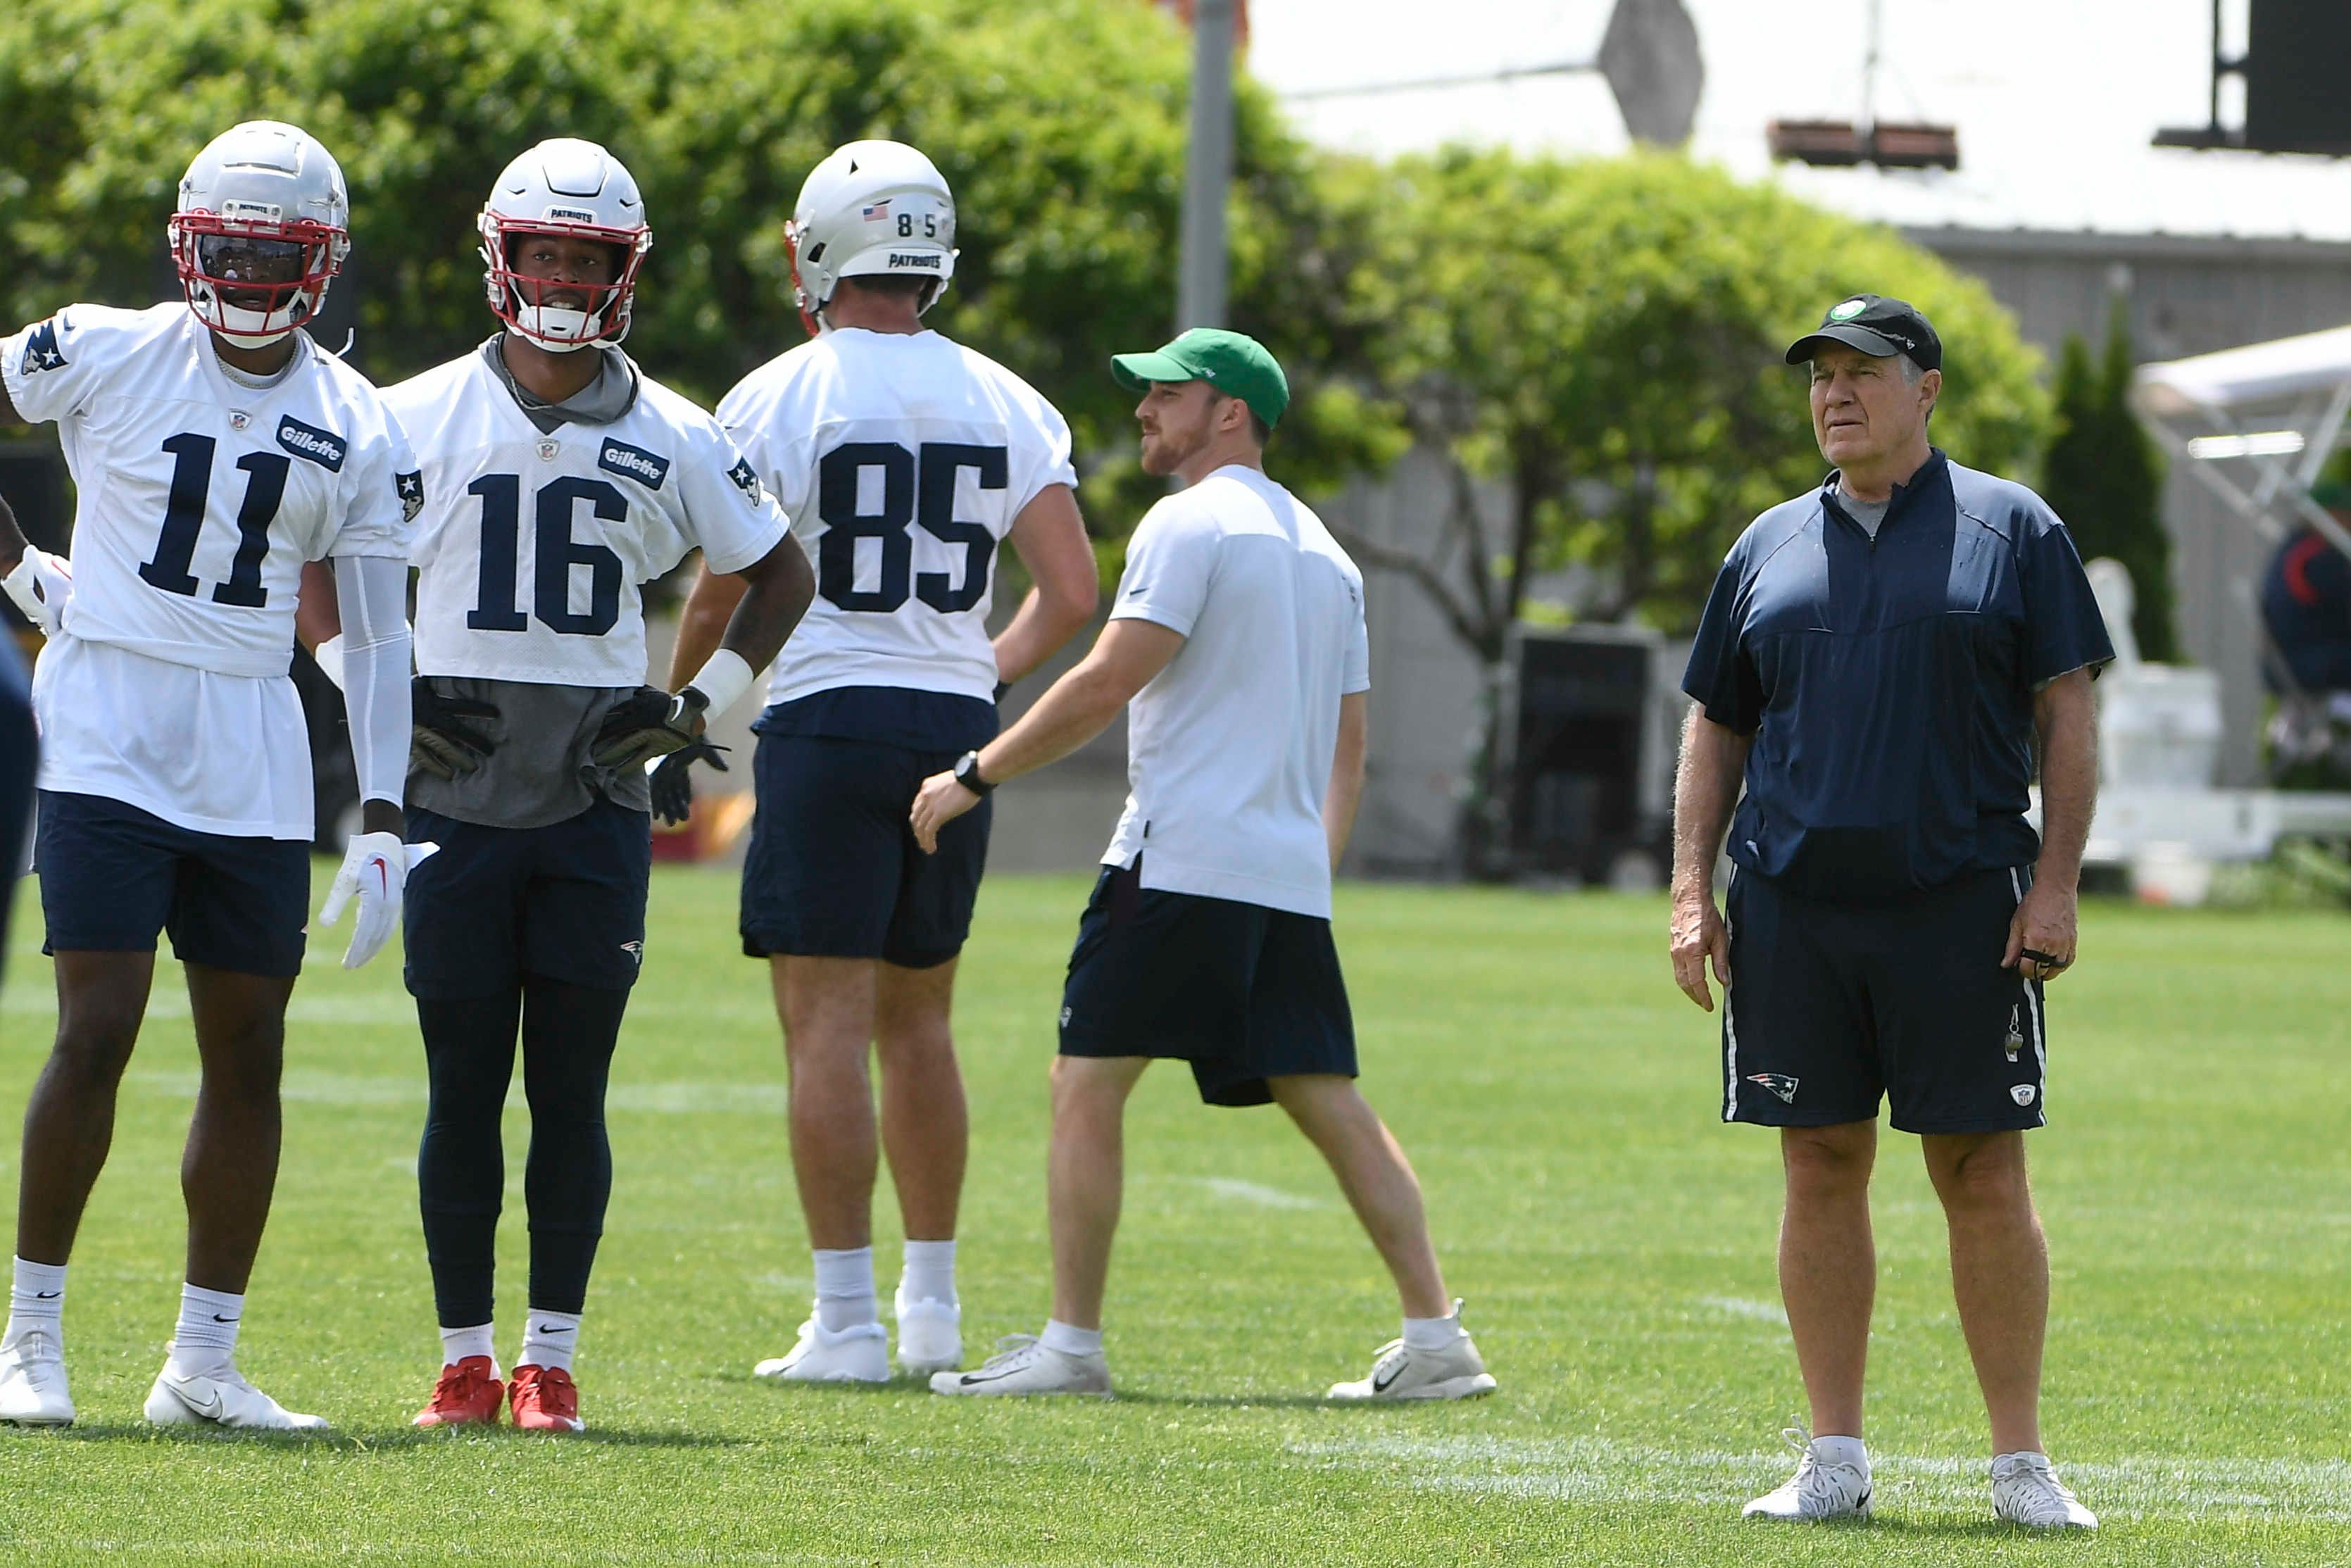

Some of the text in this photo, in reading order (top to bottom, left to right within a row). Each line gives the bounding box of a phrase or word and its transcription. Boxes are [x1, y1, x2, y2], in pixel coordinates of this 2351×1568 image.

[551, 208, 593, 223] PATRIOTS
[889, 253, 941, 269] PATRIOTS
[281, 426, 341, 460] Gillette
[605, 448, 662, 479] Gillette
[139, 432, 291, 608] 11
[819, 442, 1008, 613] 85
[468, 474, 628, 636] 16
